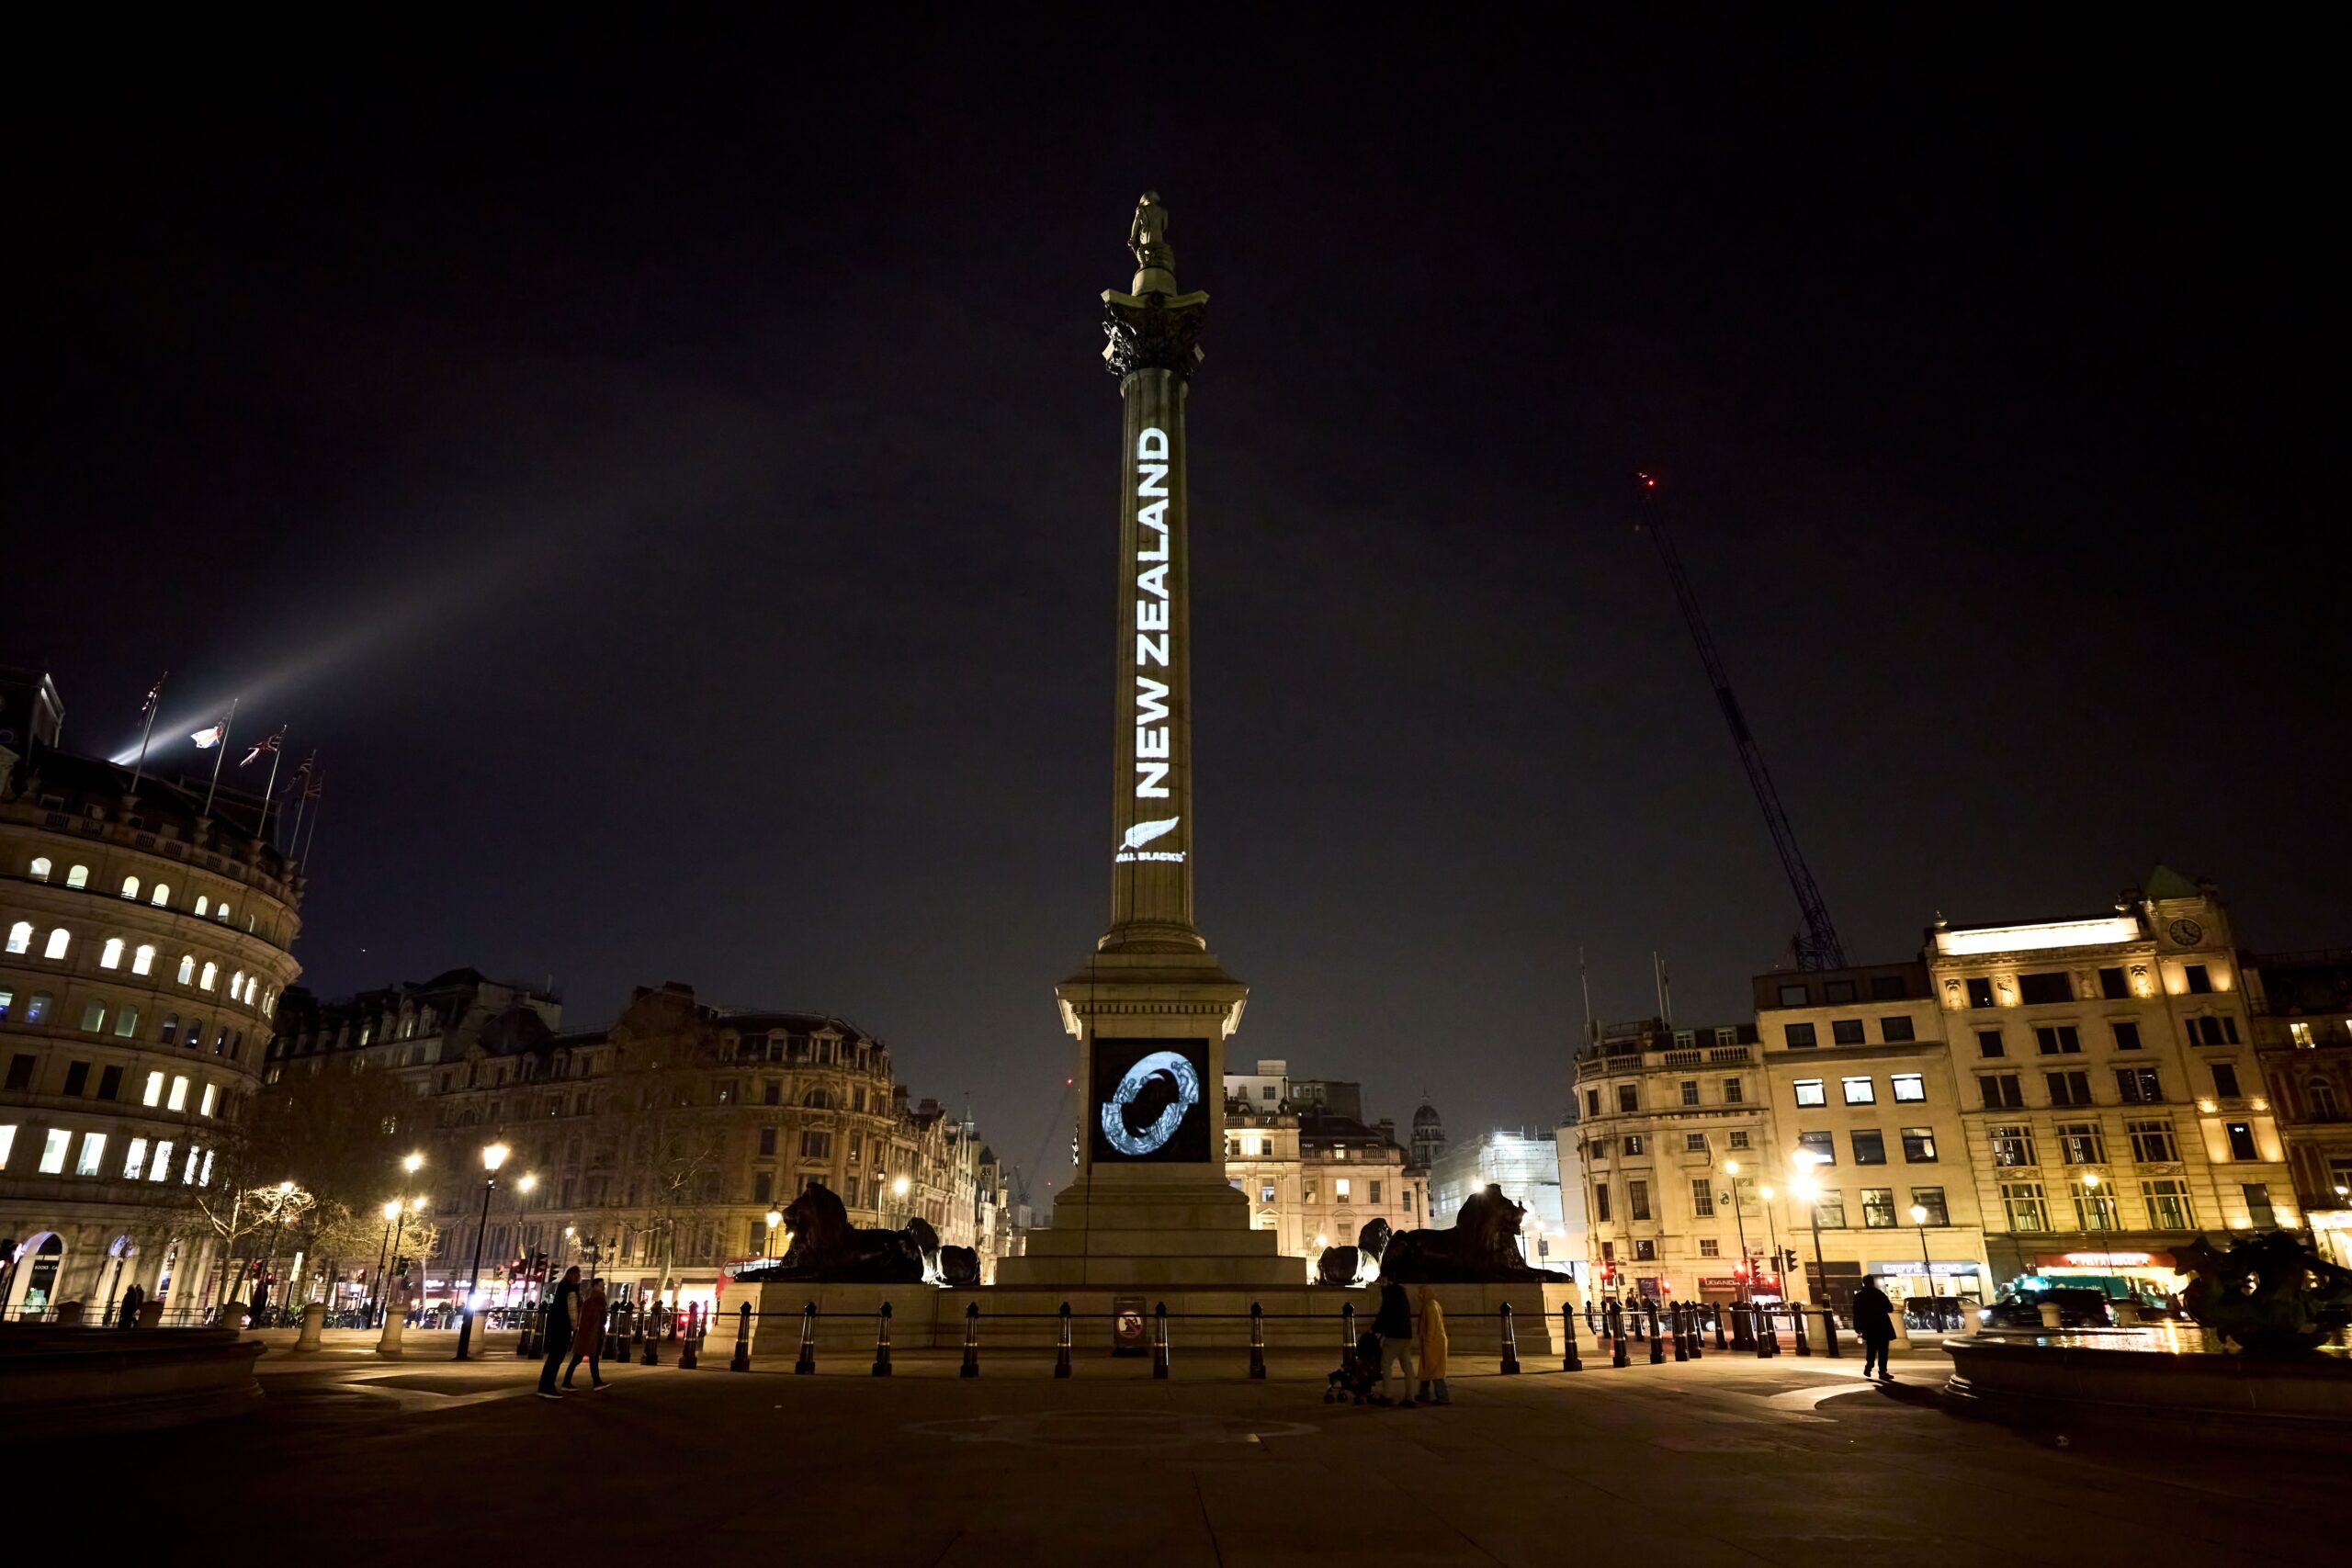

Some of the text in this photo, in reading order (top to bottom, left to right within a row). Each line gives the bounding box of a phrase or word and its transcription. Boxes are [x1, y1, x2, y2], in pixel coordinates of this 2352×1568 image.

[1136, 426, 1170, 798] NEW ZEALAND
[1115, 852, 1136, 863] ALL
